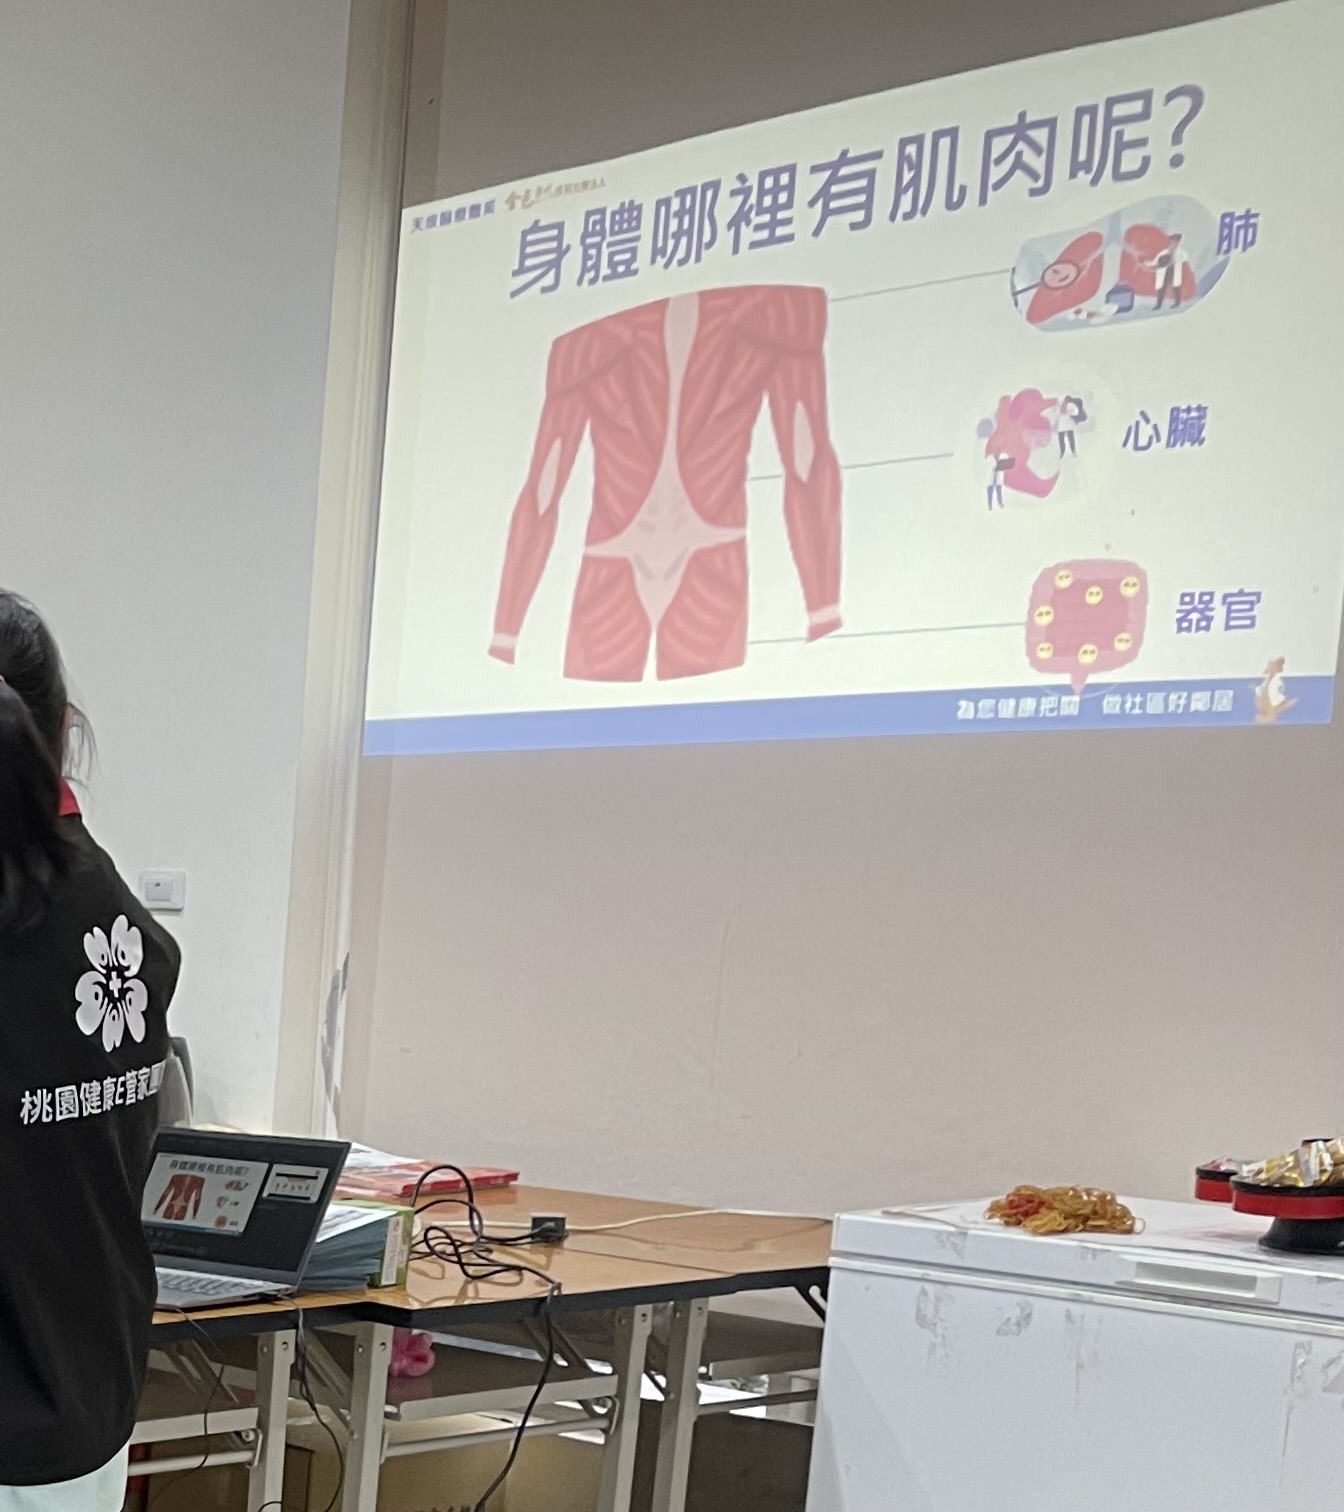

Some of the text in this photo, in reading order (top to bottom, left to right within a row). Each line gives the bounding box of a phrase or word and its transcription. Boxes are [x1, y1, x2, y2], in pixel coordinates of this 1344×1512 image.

[510, 83, 1207, 299] 身體哪裡有肌肉呢?
[1216, 209, 1261, 256] 肺
[1122, 403, 1207, 453] 心臟
[1174, 587, 1262, 635] 器官
[957, 689, 1234, 720] 為您健康把關 做社區好鄰居
